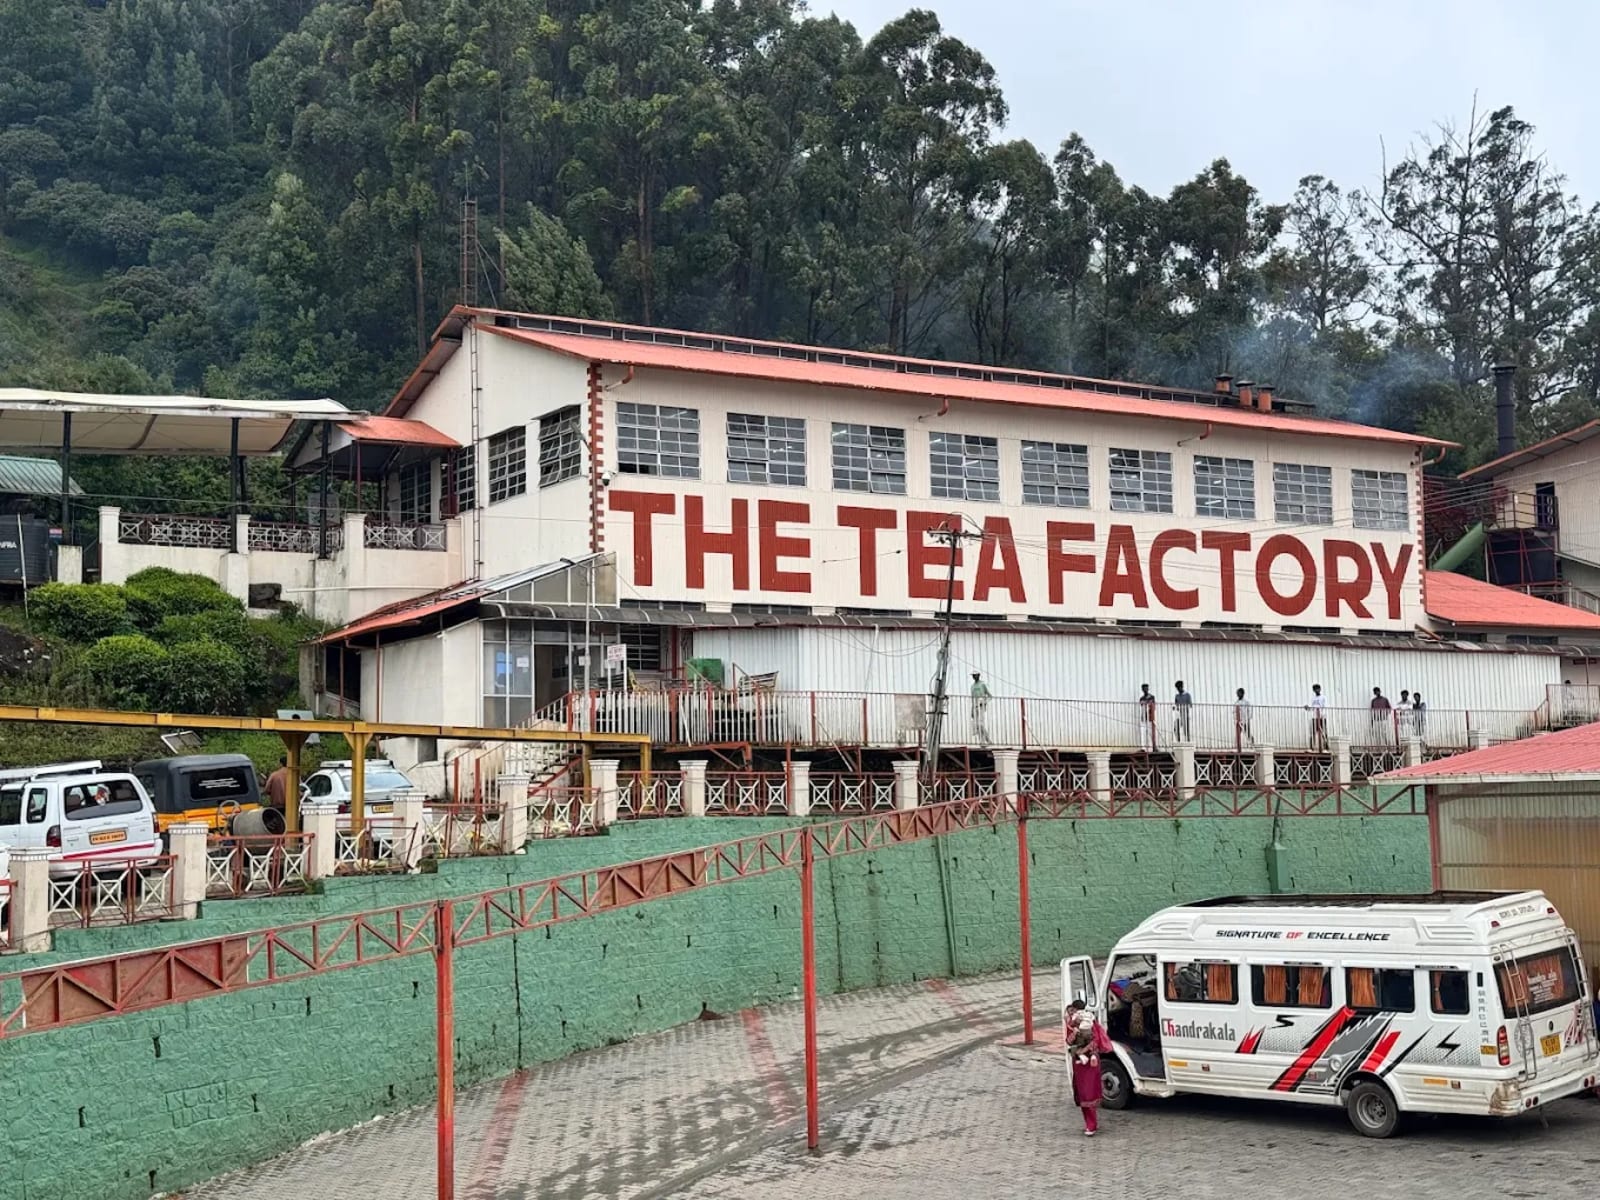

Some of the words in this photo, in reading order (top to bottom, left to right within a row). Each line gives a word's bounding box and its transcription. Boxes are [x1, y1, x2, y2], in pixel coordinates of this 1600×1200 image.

[608, 489, 812, 594] THE
[837, 505, 1028, 604] TEA
[1046, 520, 1413, 620] FACTORY
[1216, 929, 1282, 940] SIGNATURE
[1286, 931, 1304, 940] OF
[1307, 931, 1391, 942] EXCELLENCE
[1160, 1018, 1236, 1042] Chandrakala
